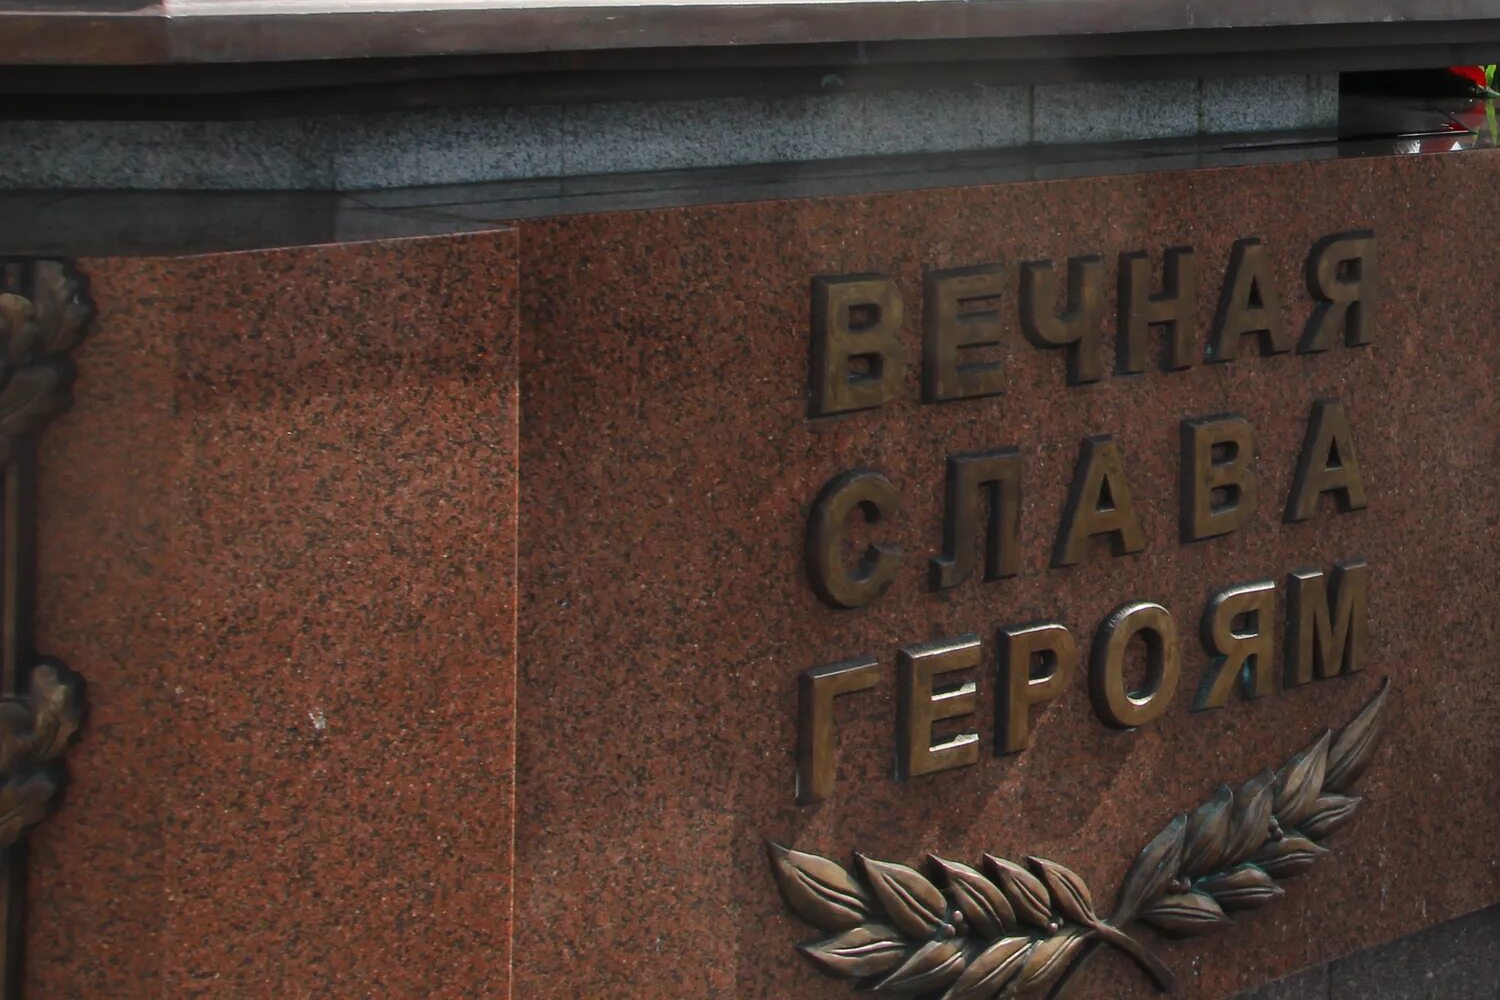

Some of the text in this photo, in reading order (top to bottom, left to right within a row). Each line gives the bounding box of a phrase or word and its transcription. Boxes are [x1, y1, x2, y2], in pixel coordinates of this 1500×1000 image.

[809, 232, 1376, 418] ВЕЧНАЯ
[807, 402, 1366, 609] СЛАВА
[797, 560, 1368, 802] ГЕРОЯМ
